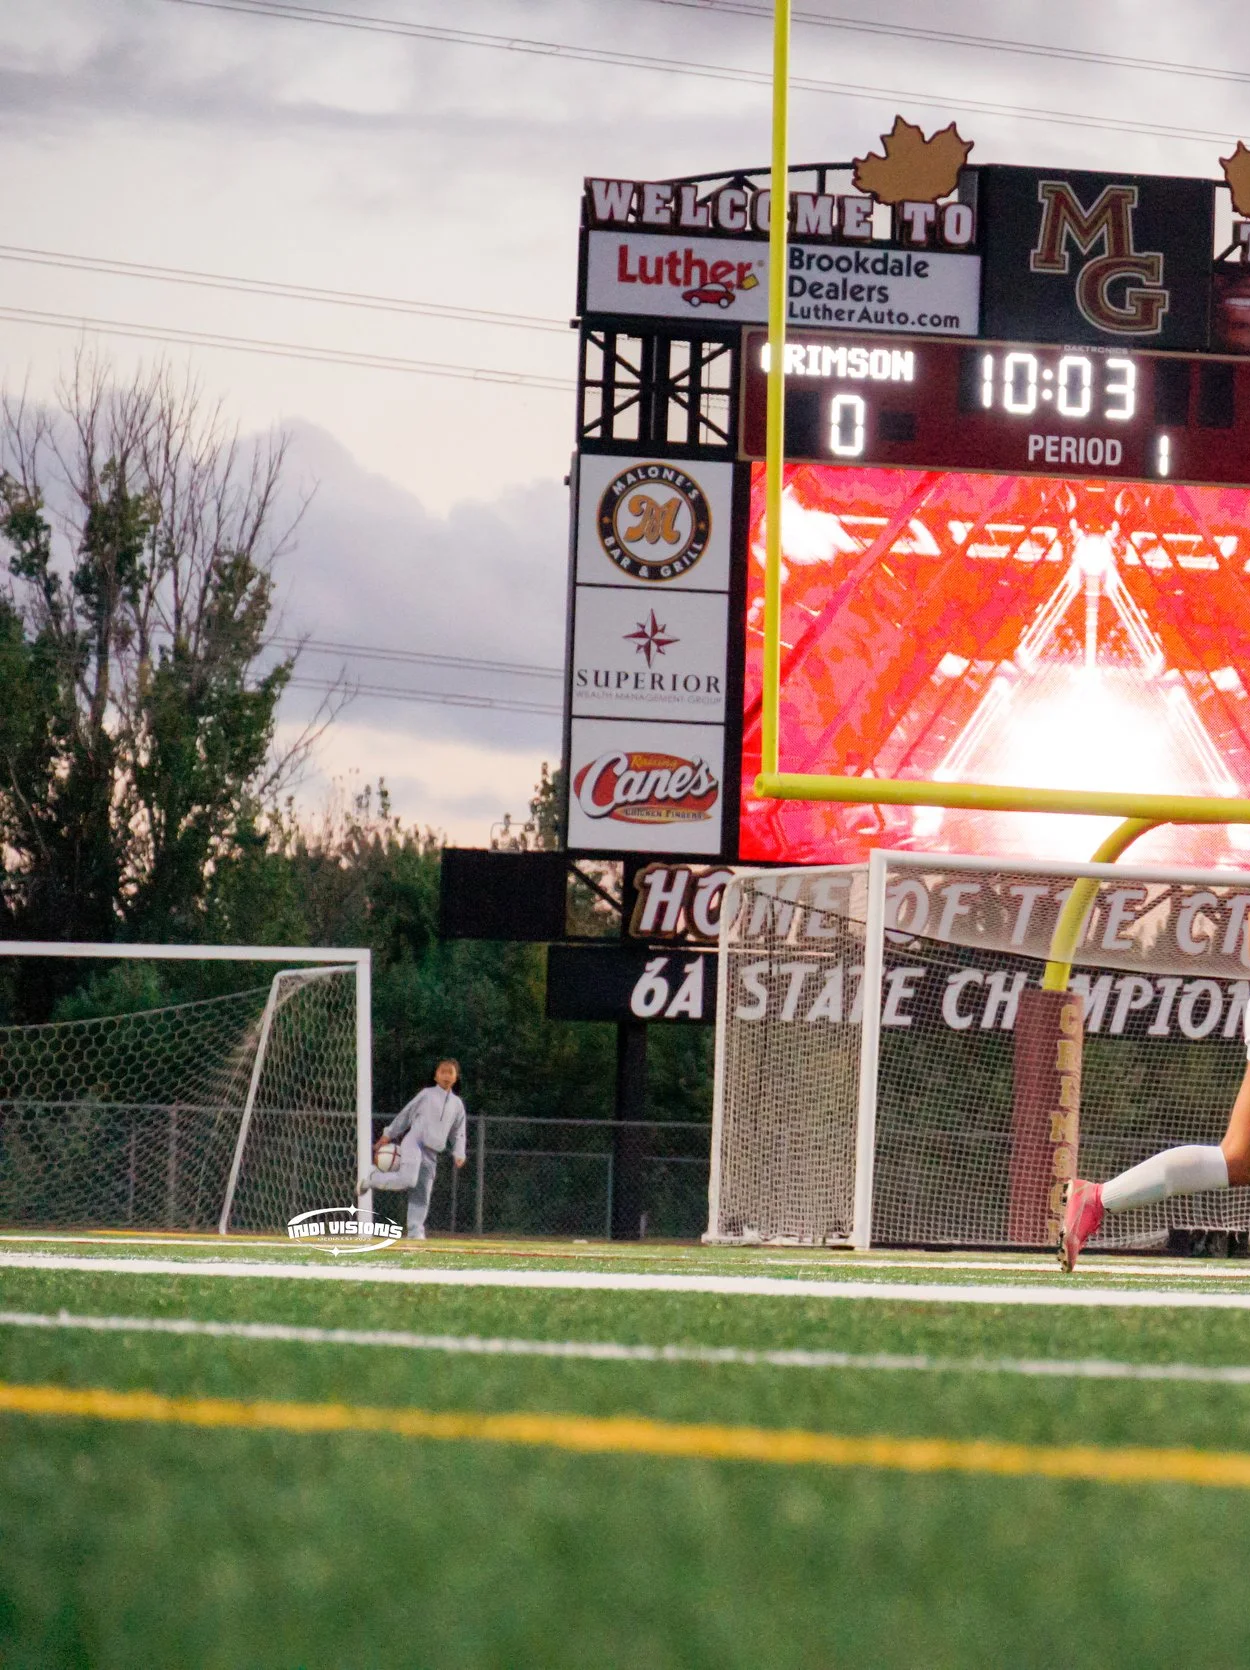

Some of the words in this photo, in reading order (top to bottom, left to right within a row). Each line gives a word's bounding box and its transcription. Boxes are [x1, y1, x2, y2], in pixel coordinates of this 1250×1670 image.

[903, 201, 974, 245] TO
[617, 244, 753, 290] Luther
[788, 247, 930, 279] Brookdale
[788, 274, 890, 304] Dealers
[788, 302, 960, 329] LutherAuto.com
[1063, 344, 1129, 355] DAKTRONICS
[981, 351, 1136, 420] 10:03
[829, 393, 865, 457] 0
[1027, 434, 1123, 466] PERIOD
[1158, 434, 1169, 477] 1
[612, 466, 700, 500] MALONE'S
[604, 536, 632, 569] BAR
[660, 543, 703, 578] GRILL
[576, 668, 721, 694] SUPERIOR
[579, 751, 718, 818] Cane's
[639, 869, 853, 938] HOME
[630, 953, 704, 1019] 6A
